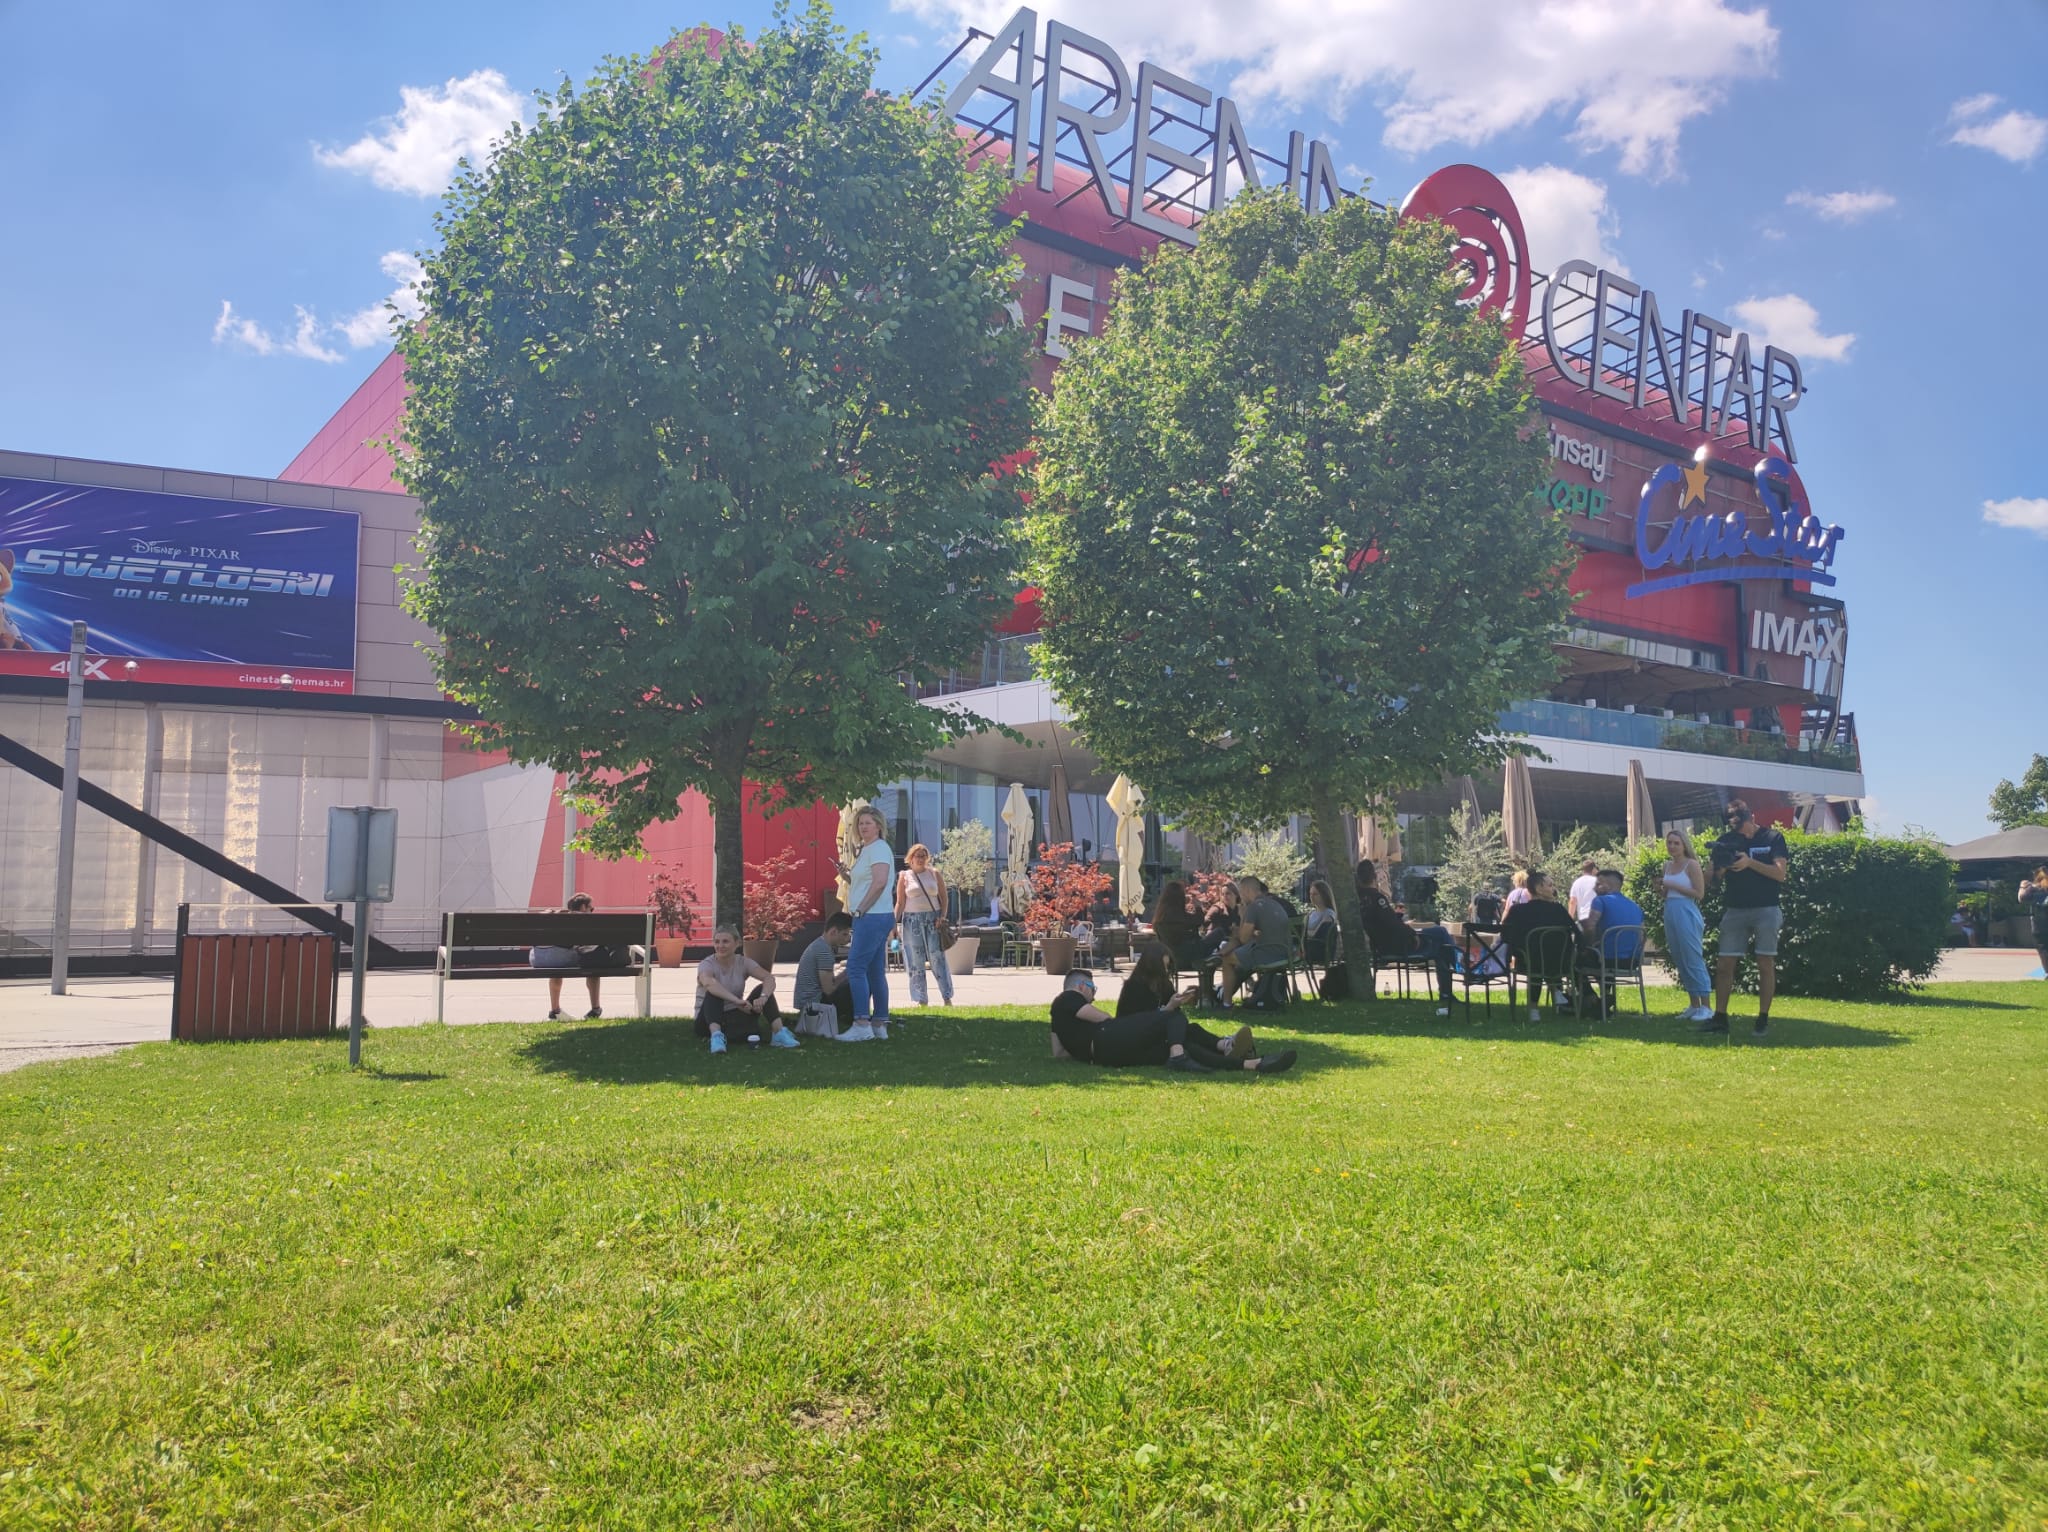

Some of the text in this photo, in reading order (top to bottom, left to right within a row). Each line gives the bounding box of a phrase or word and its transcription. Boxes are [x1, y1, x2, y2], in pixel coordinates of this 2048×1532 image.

[1542, 258, 1803, 464] CENTAR
[1546, 422, 1607, 483] insay
[1636, 457, 1845, 570] CineStar
[21, 549, 335, 596] SVJETLOSNI
[191, 546, 240, 560] PIXAR
[113, 588, 249, 607] OD 16. LIPNJA
[1751, 610, 1848, 664] IMAX
[239, 674, 345, 688] cinestainemas.hr
